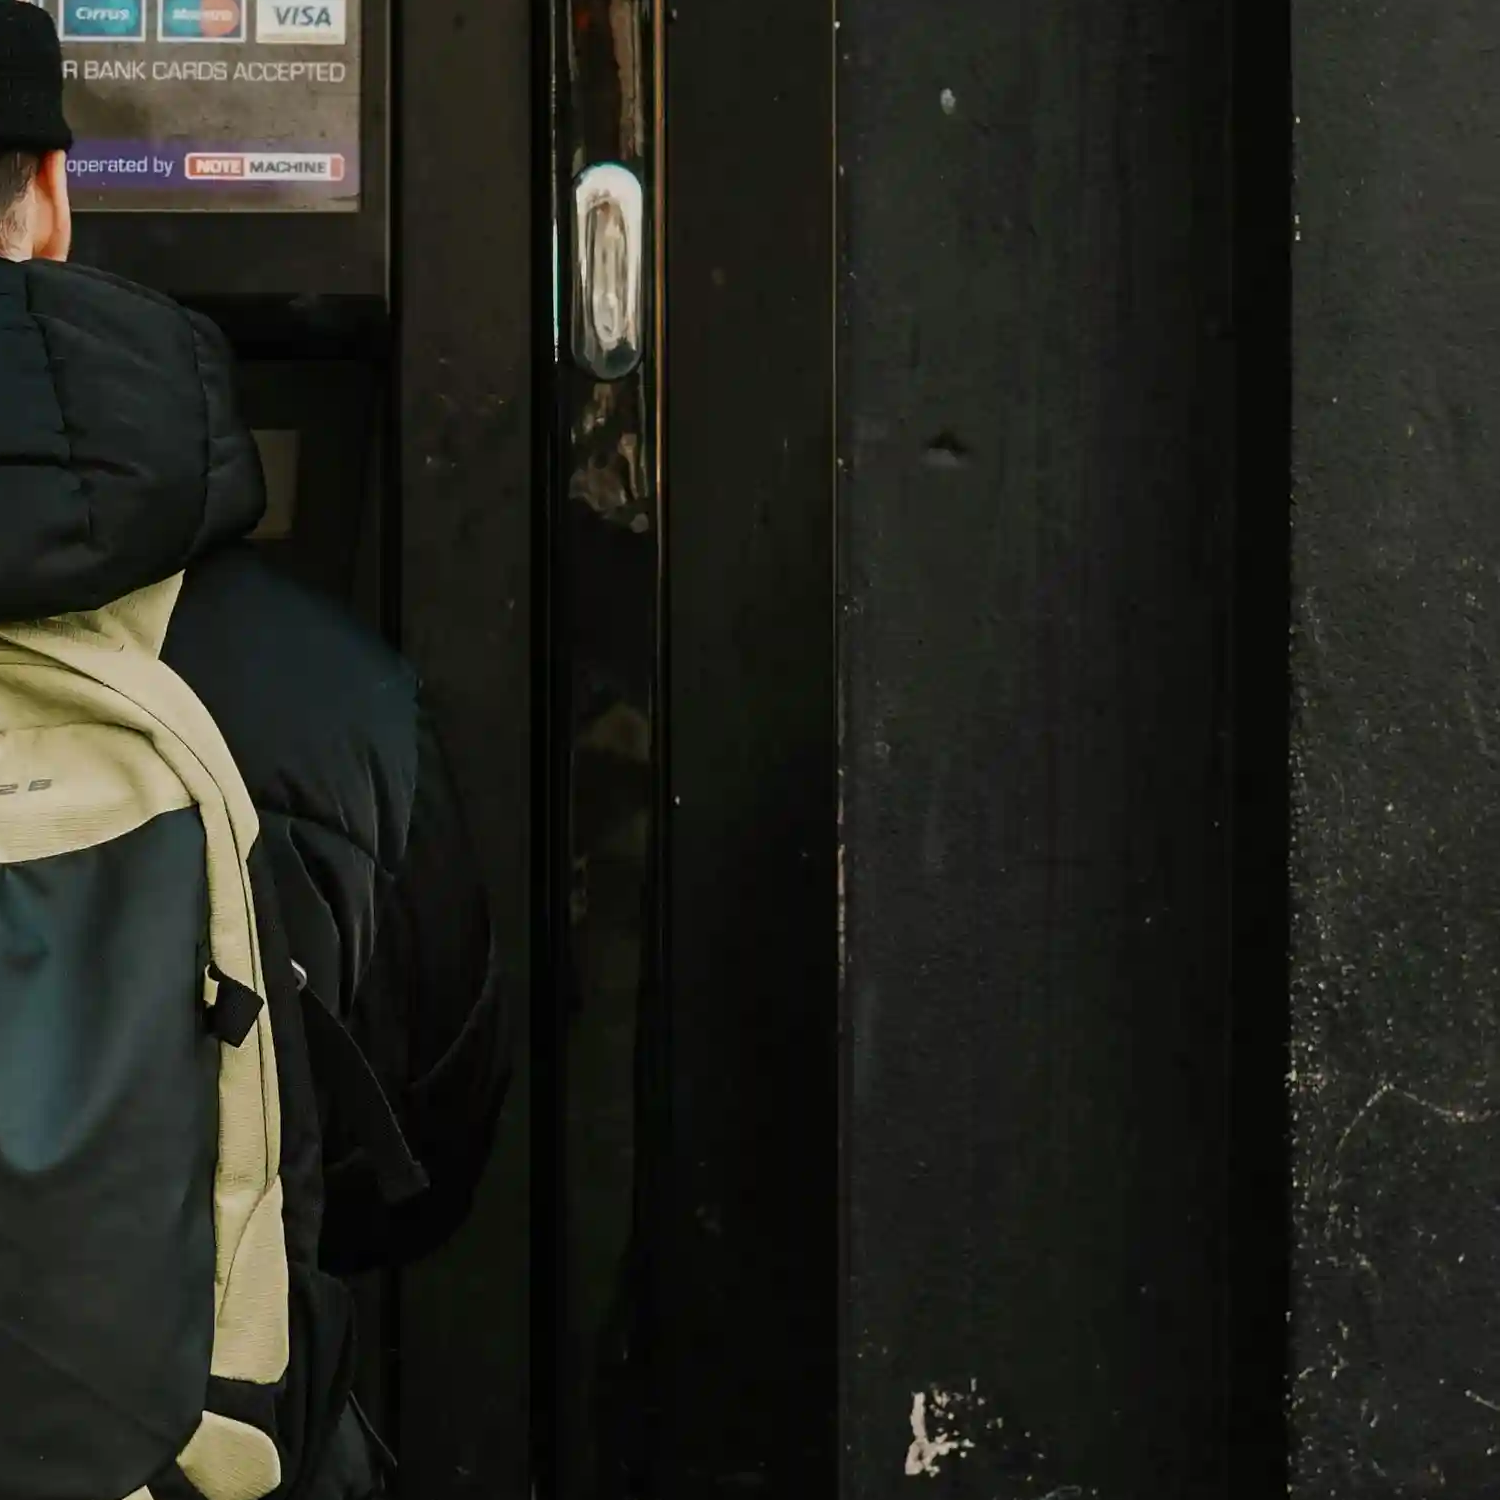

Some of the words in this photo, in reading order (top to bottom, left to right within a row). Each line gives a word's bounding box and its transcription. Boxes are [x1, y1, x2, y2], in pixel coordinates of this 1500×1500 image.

[272, 5, 332, 28] VISA
[84, 60, 147, 80] BANK
[152, 61, 227, 81] CARDS
[233, 62, 346, 83] ACCEPTED
[66, 155, 148, 177] operated
[153, 156, 174, 176] by
